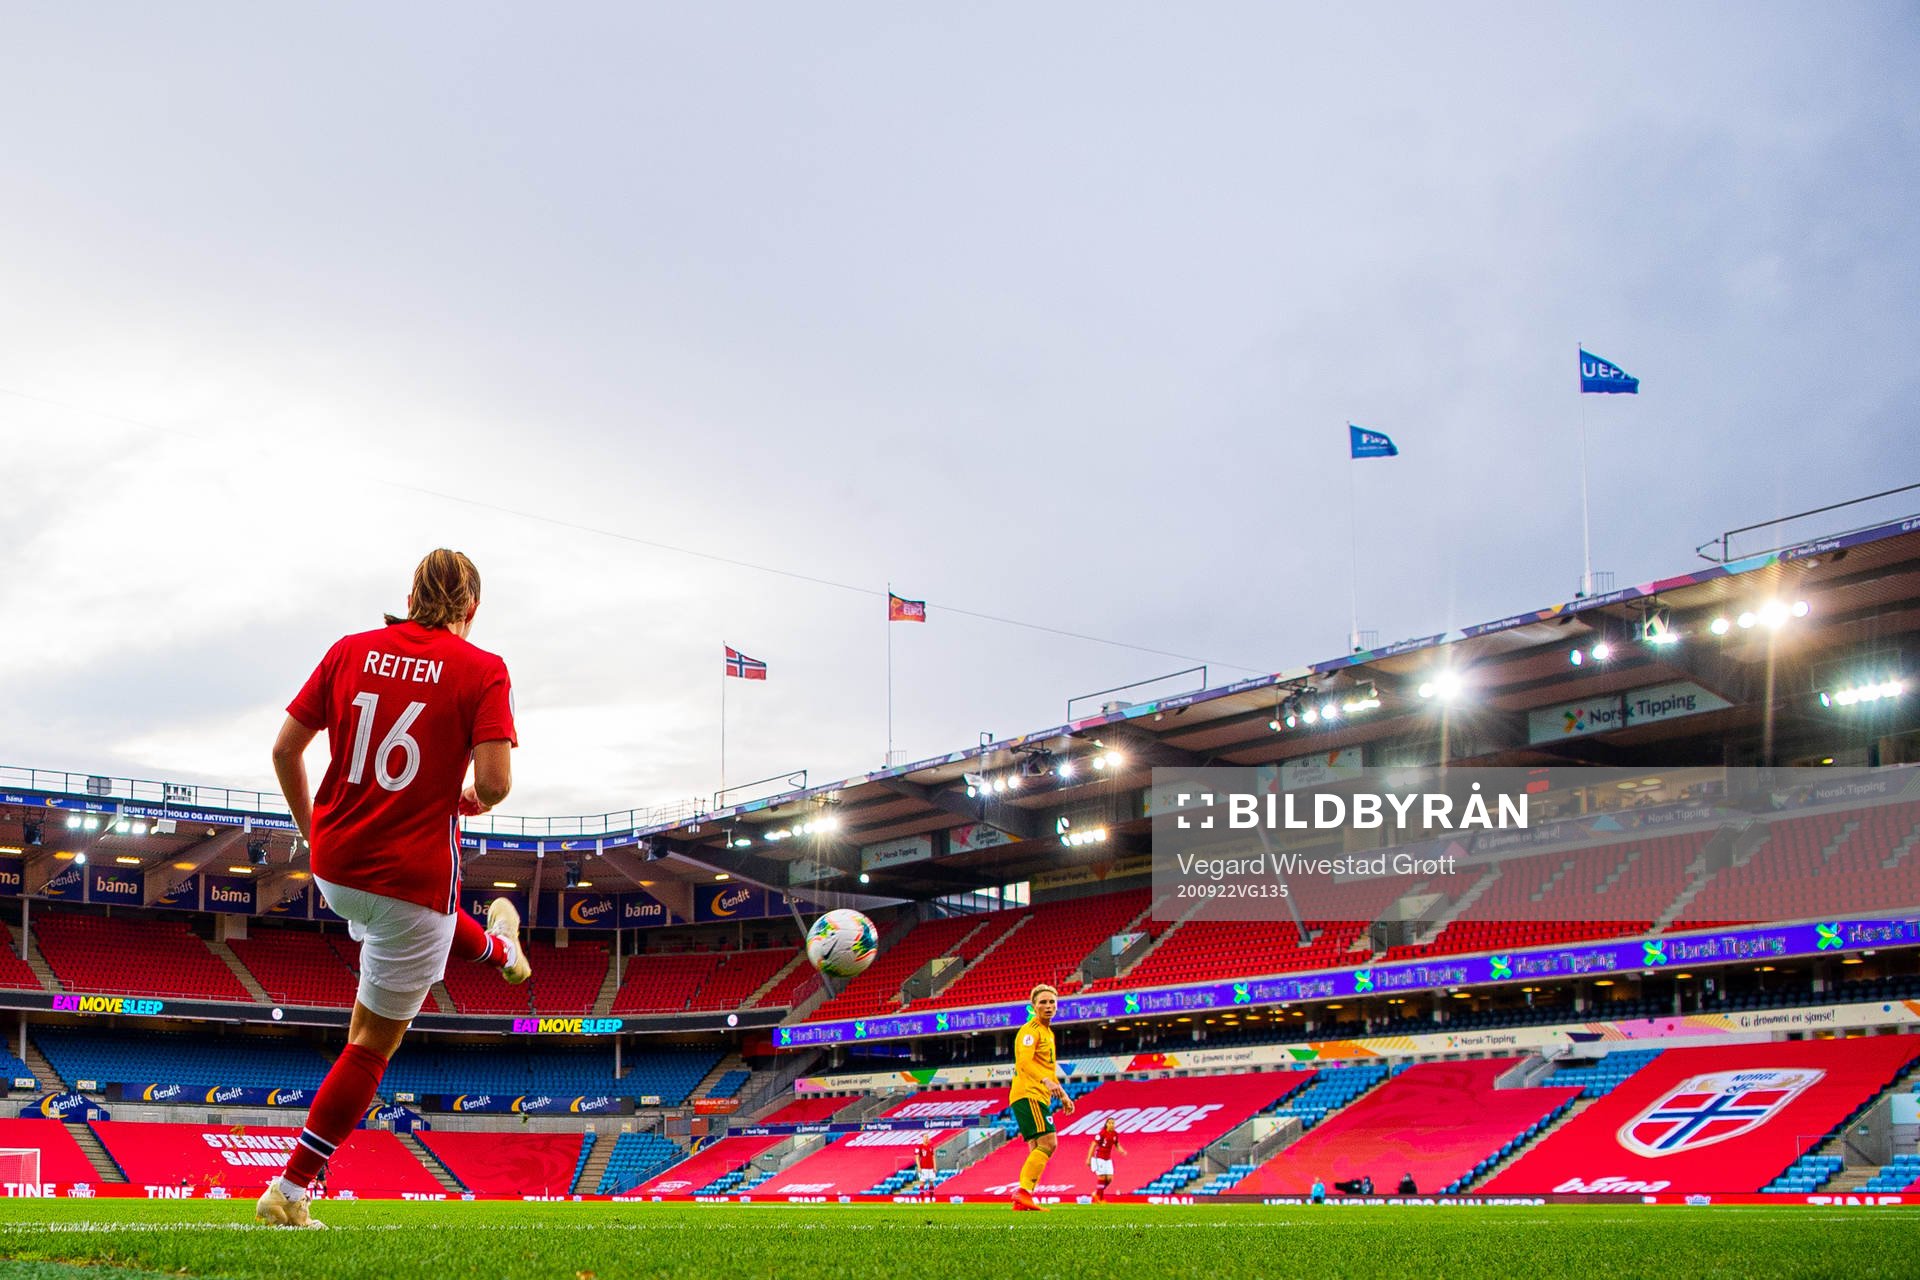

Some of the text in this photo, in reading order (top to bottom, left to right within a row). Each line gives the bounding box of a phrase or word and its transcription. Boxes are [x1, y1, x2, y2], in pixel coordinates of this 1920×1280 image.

[1582, 362, 1625, 379] UEF
[363, 651, 443, 684] REITEN
[1590, 694, 1697, 725] Norsk Tipping
[347, 691, 421, 792] 16
[1816, 781, 1886, 799] Norsk Tipping
[124, 806, 145, 816] SUNT
[147, 807, 190, 819] KOSTHOLD
[191, 812, 203, 820] OG
[203, 813, 243, 825] AKTIVITET
[251, 818, 265, 826] GIR
[1648, 806, 1711, 823] Norsk Tipping
[721, 889, 751, 909] Bendit
[582, 899, 613, 918] Bendit
[152, 1083, 182, 1101] Bendit
[215, 1086, 244, 1103] Bendit
[277, 1089, 306, 1106] Bendit
[52, 1094, 84, 1111] Bendit
[462, 1094, 491, 1111] Bendit
[521, 1095, 550, 1112] Bendit
[580, 1095, 609, 1112] Bendit
[378, 1106, 406, 1122] Bendit
[1057, 1103, 1225, 1137] NORGE
[202, 1133, 300, 1150] STERKER
[4, 1183, 57, 1198] TINE
